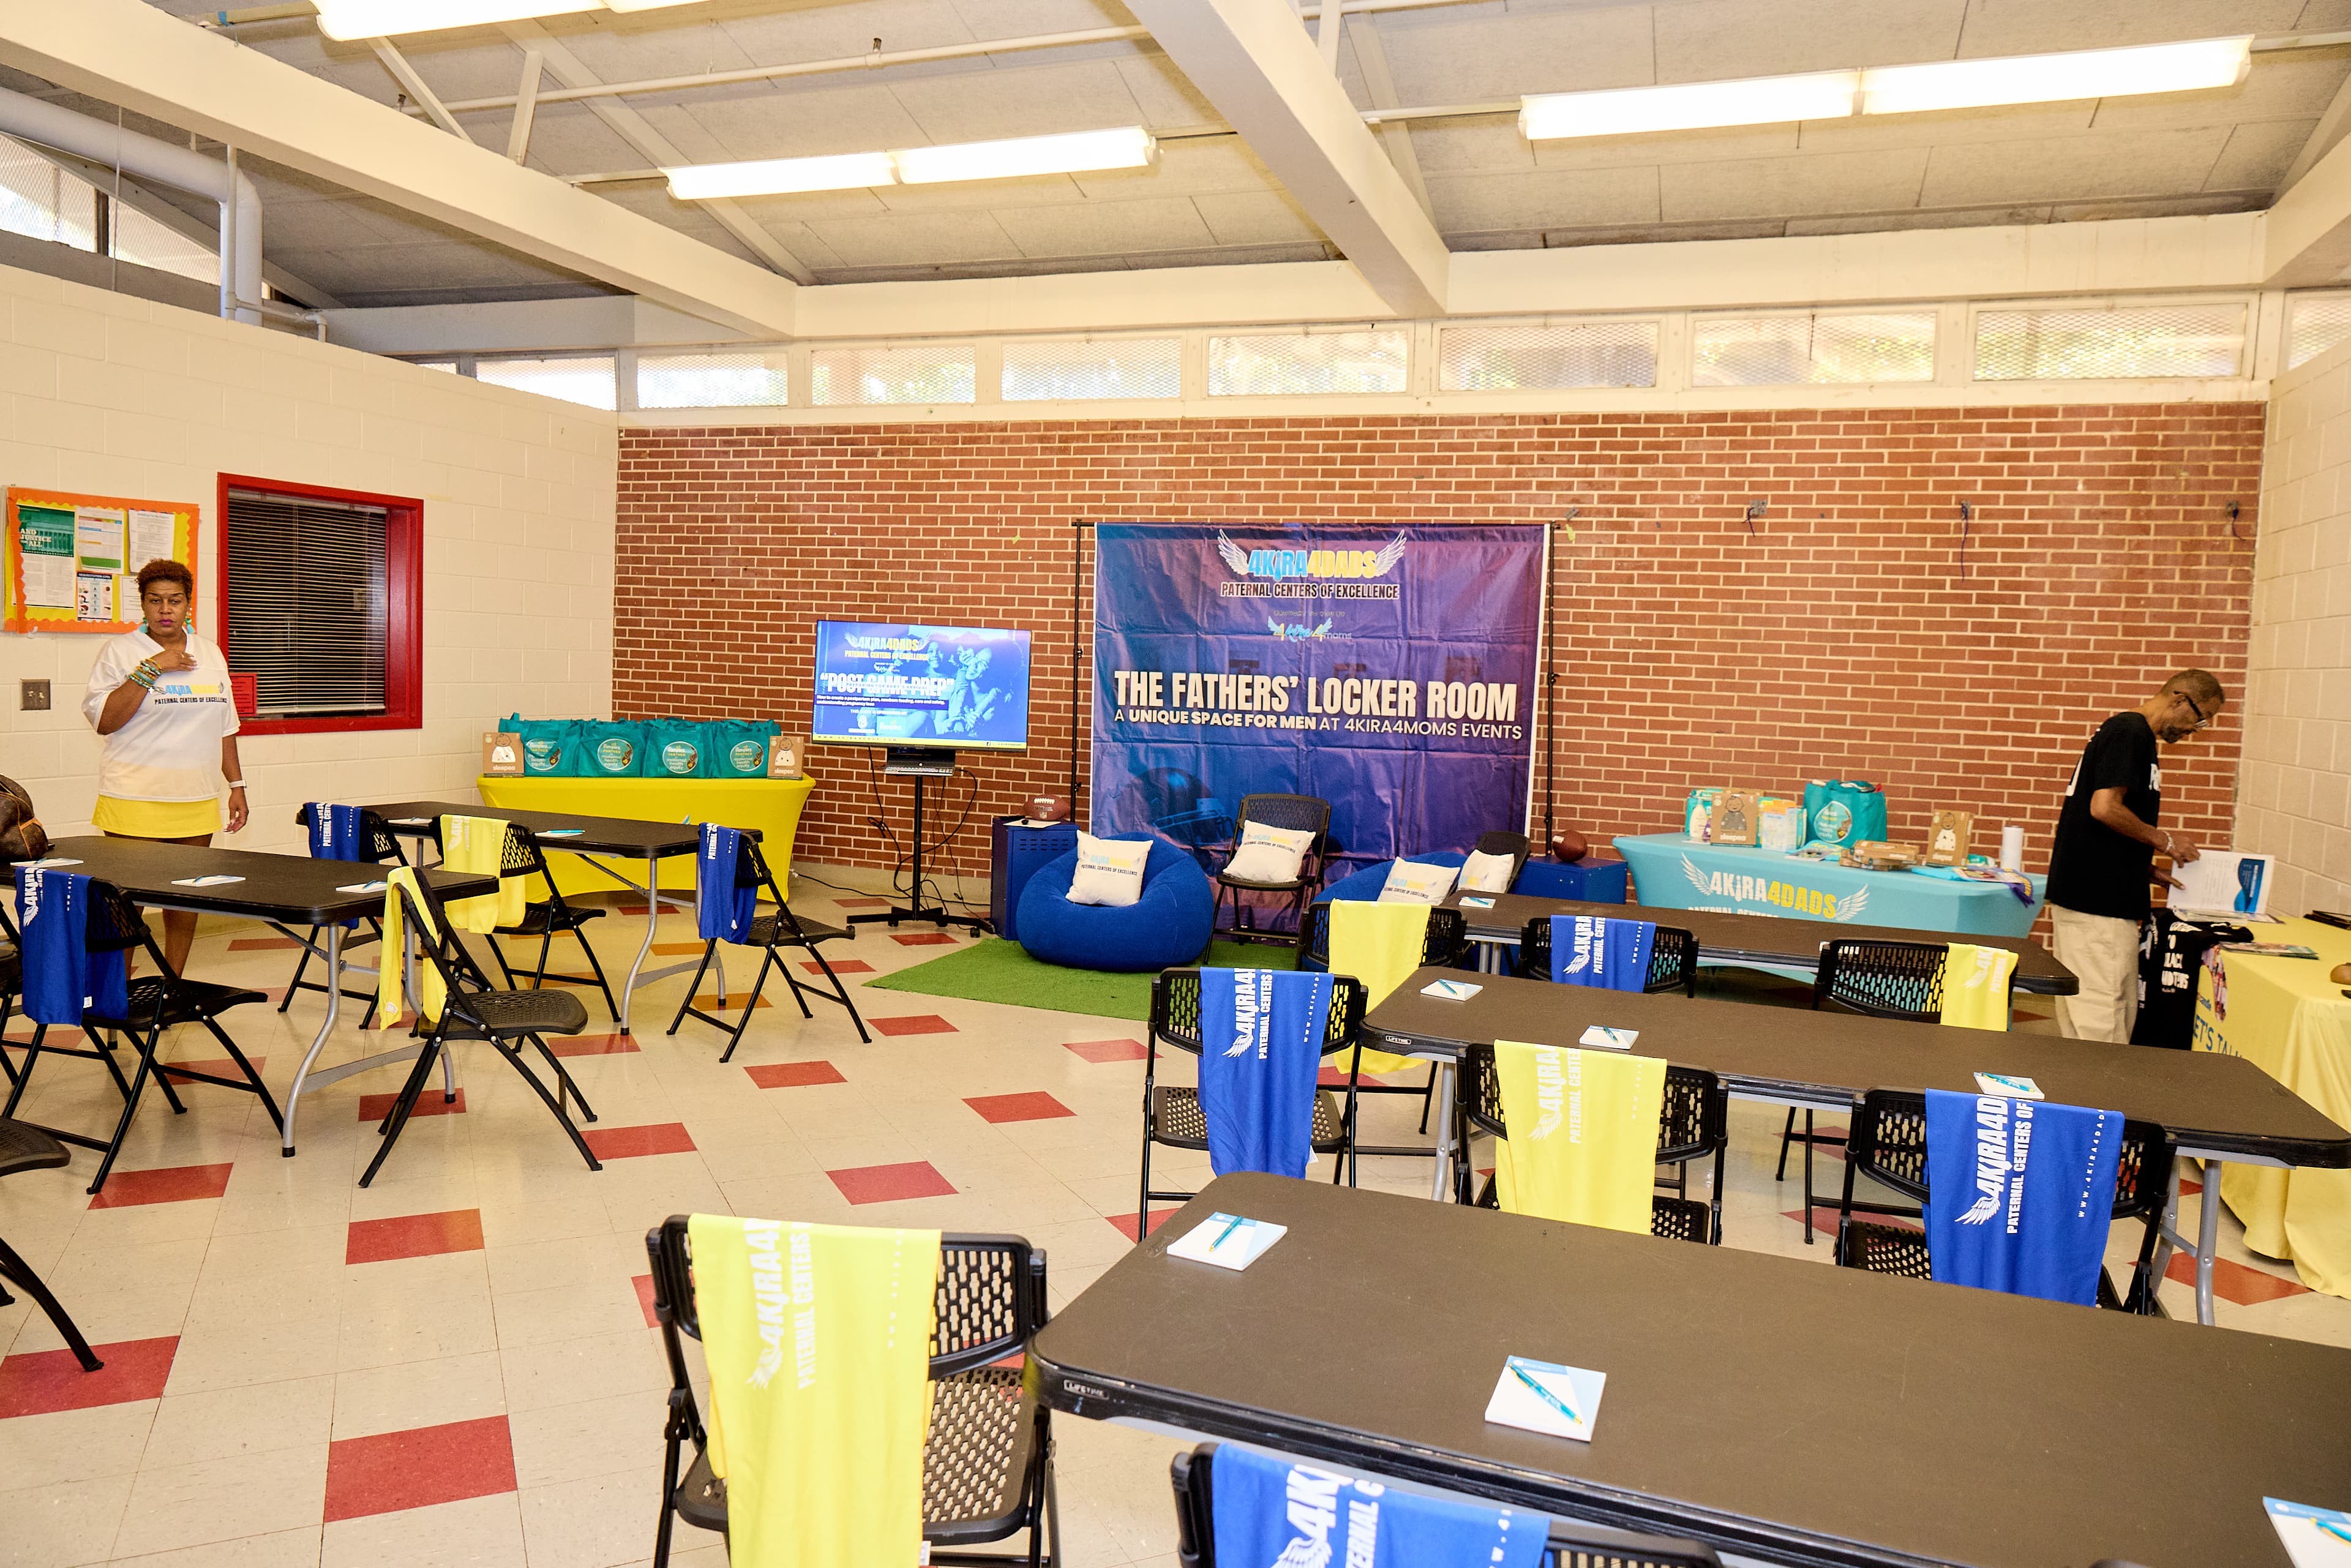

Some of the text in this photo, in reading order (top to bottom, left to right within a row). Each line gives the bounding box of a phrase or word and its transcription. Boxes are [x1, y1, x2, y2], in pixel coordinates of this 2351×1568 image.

[20, 534, 51, 542] JUSTICE
[1221, 582, 1400, 599] PATERNAL CENTERS OF EXCELLENCE
[1114, 671, 1164, 707] THE
[1307, 677, 1417, 718] LOCKER
[1427, 681, 1517, 721] ROOM
[1114, 709, 1522, 740] A UNIQUE SPACE FOR MEN AT 4KIRA4MOMS EVENTS
[323, 820, 331, 846] PATERNAL
[1720, 833, 1747, 842] sleepea
[1593, 939, 1604, 974] PATERNAL
[1260, 974, 1273, 1013] CENTERS
[1259, 1015, 1270, 1059] PATERNAL
[2194, 1014, 2214, 1051] ET'S
[1569, 1090, 1581, 1144] PATERNAL
[2007, 1103, 2034, 1234] PATERNAL CENTERS OF
[790, 1232, 814, 1304] CENTERS
[794, 1307, 816, 1390] PATERNAL
